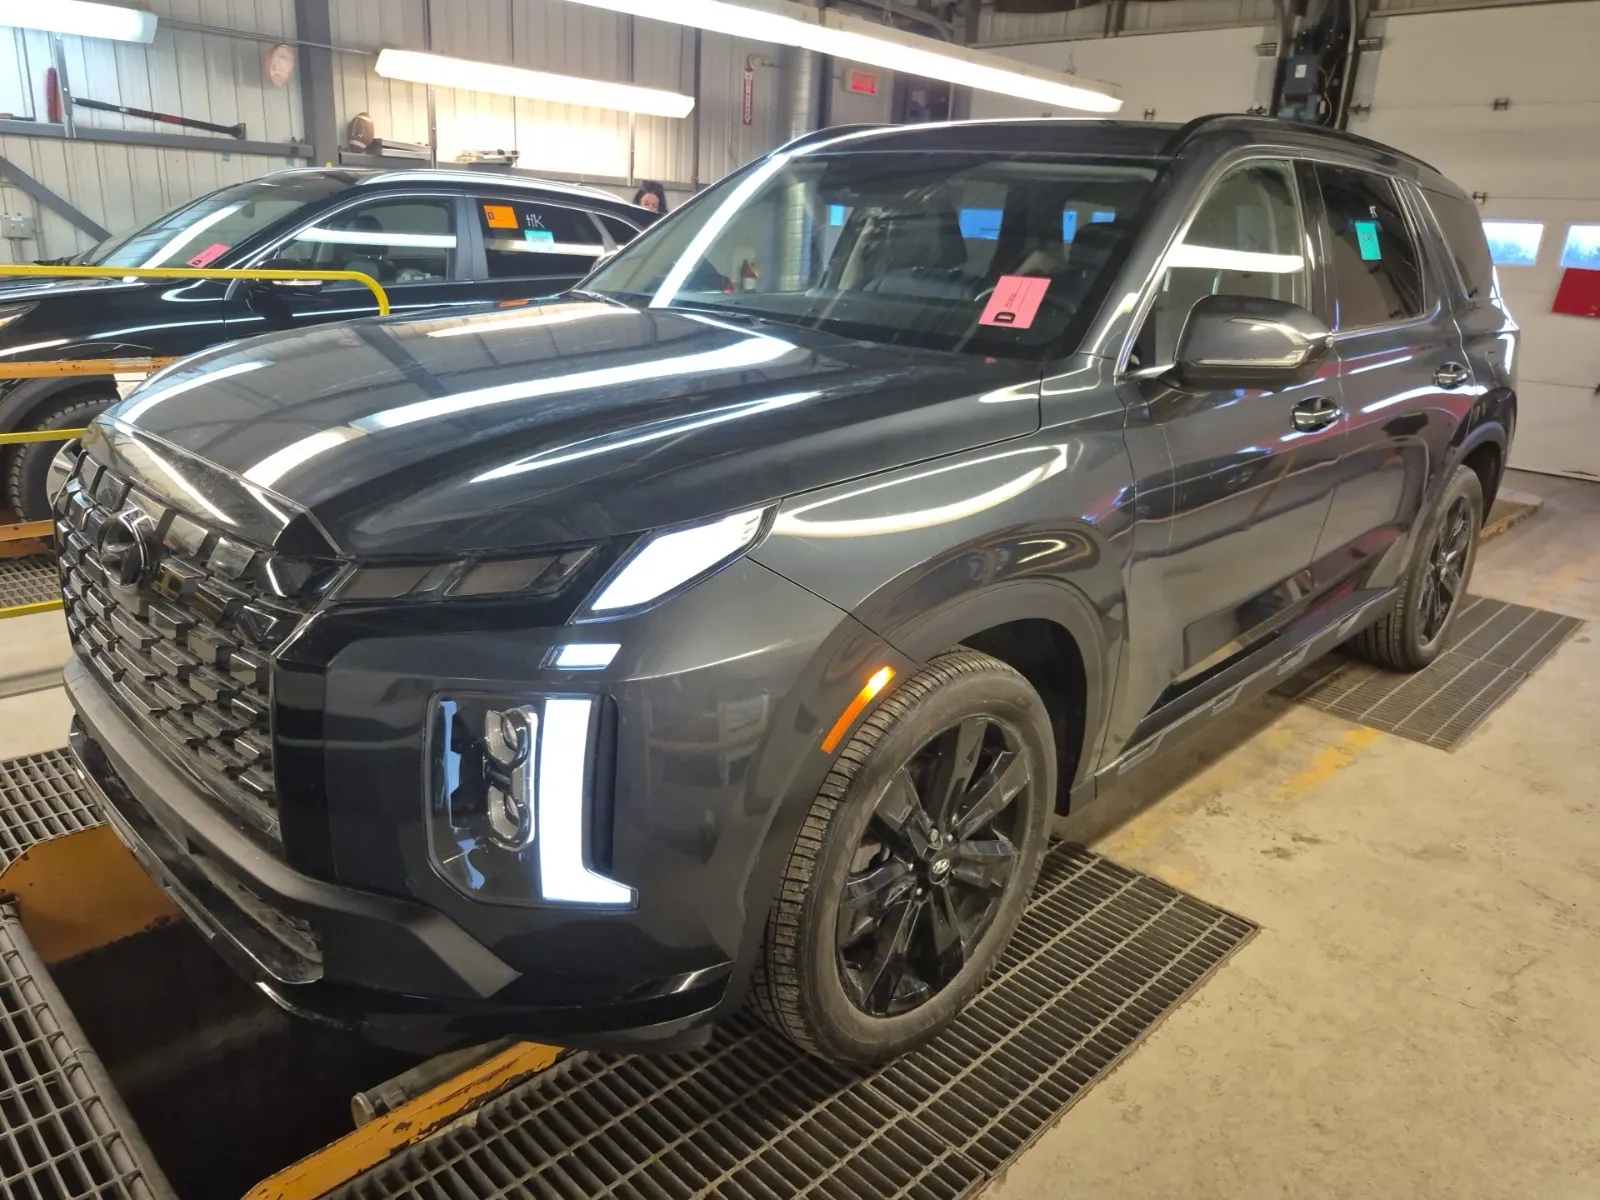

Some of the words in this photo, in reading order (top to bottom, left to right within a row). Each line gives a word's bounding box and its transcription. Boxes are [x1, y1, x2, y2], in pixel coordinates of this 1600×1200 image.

[487, 211, 495, 221] B
[525, 213, 545, 229] HK
[993, 311, 1016, 324] D
